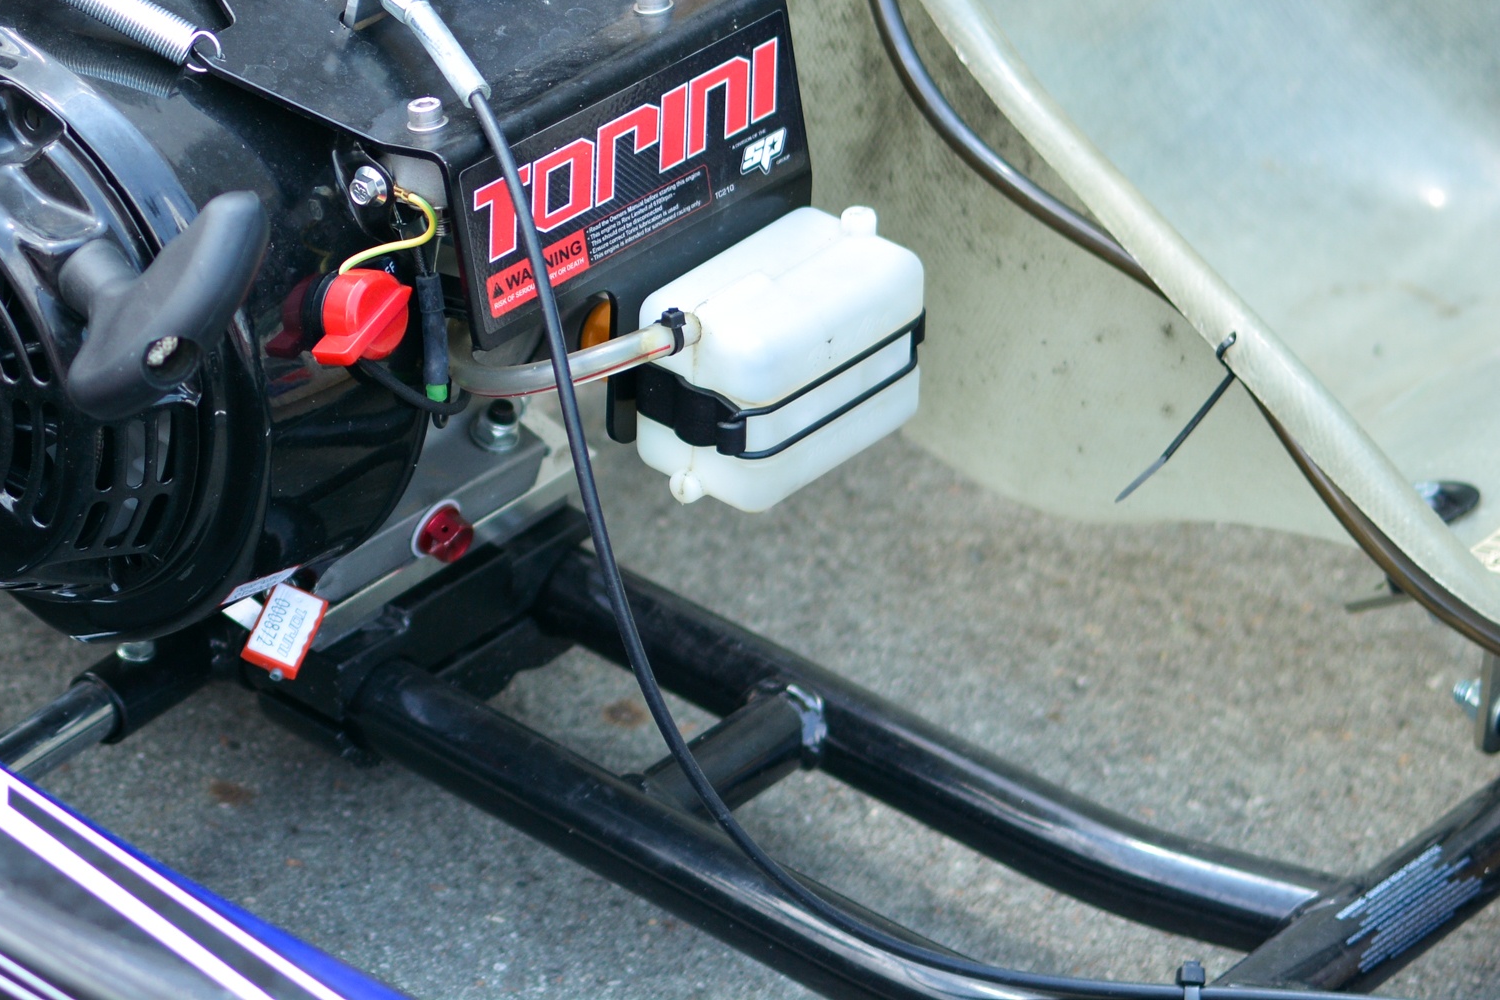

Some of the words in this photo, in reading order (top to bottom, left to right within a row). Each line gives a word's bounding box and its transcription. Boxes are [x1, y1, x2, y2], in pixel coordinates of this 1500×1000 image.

[473, 37, 779, 264] TORINI
[741, 127, 785, 171] SP
[714, 184, 736, 200] TC210
[494, 296, 506, 309] RISK
[507, 292, 514, 303] OF
[515, 282, 535, 298] SERIOU
[557, 266, 565, 275] OR
[566, 256, 584, 271] DEATH
[505, 239, 582, 289] WANING
[257, 597, 291, 647] 000872
[278, 607, 308, 658] TORINI
